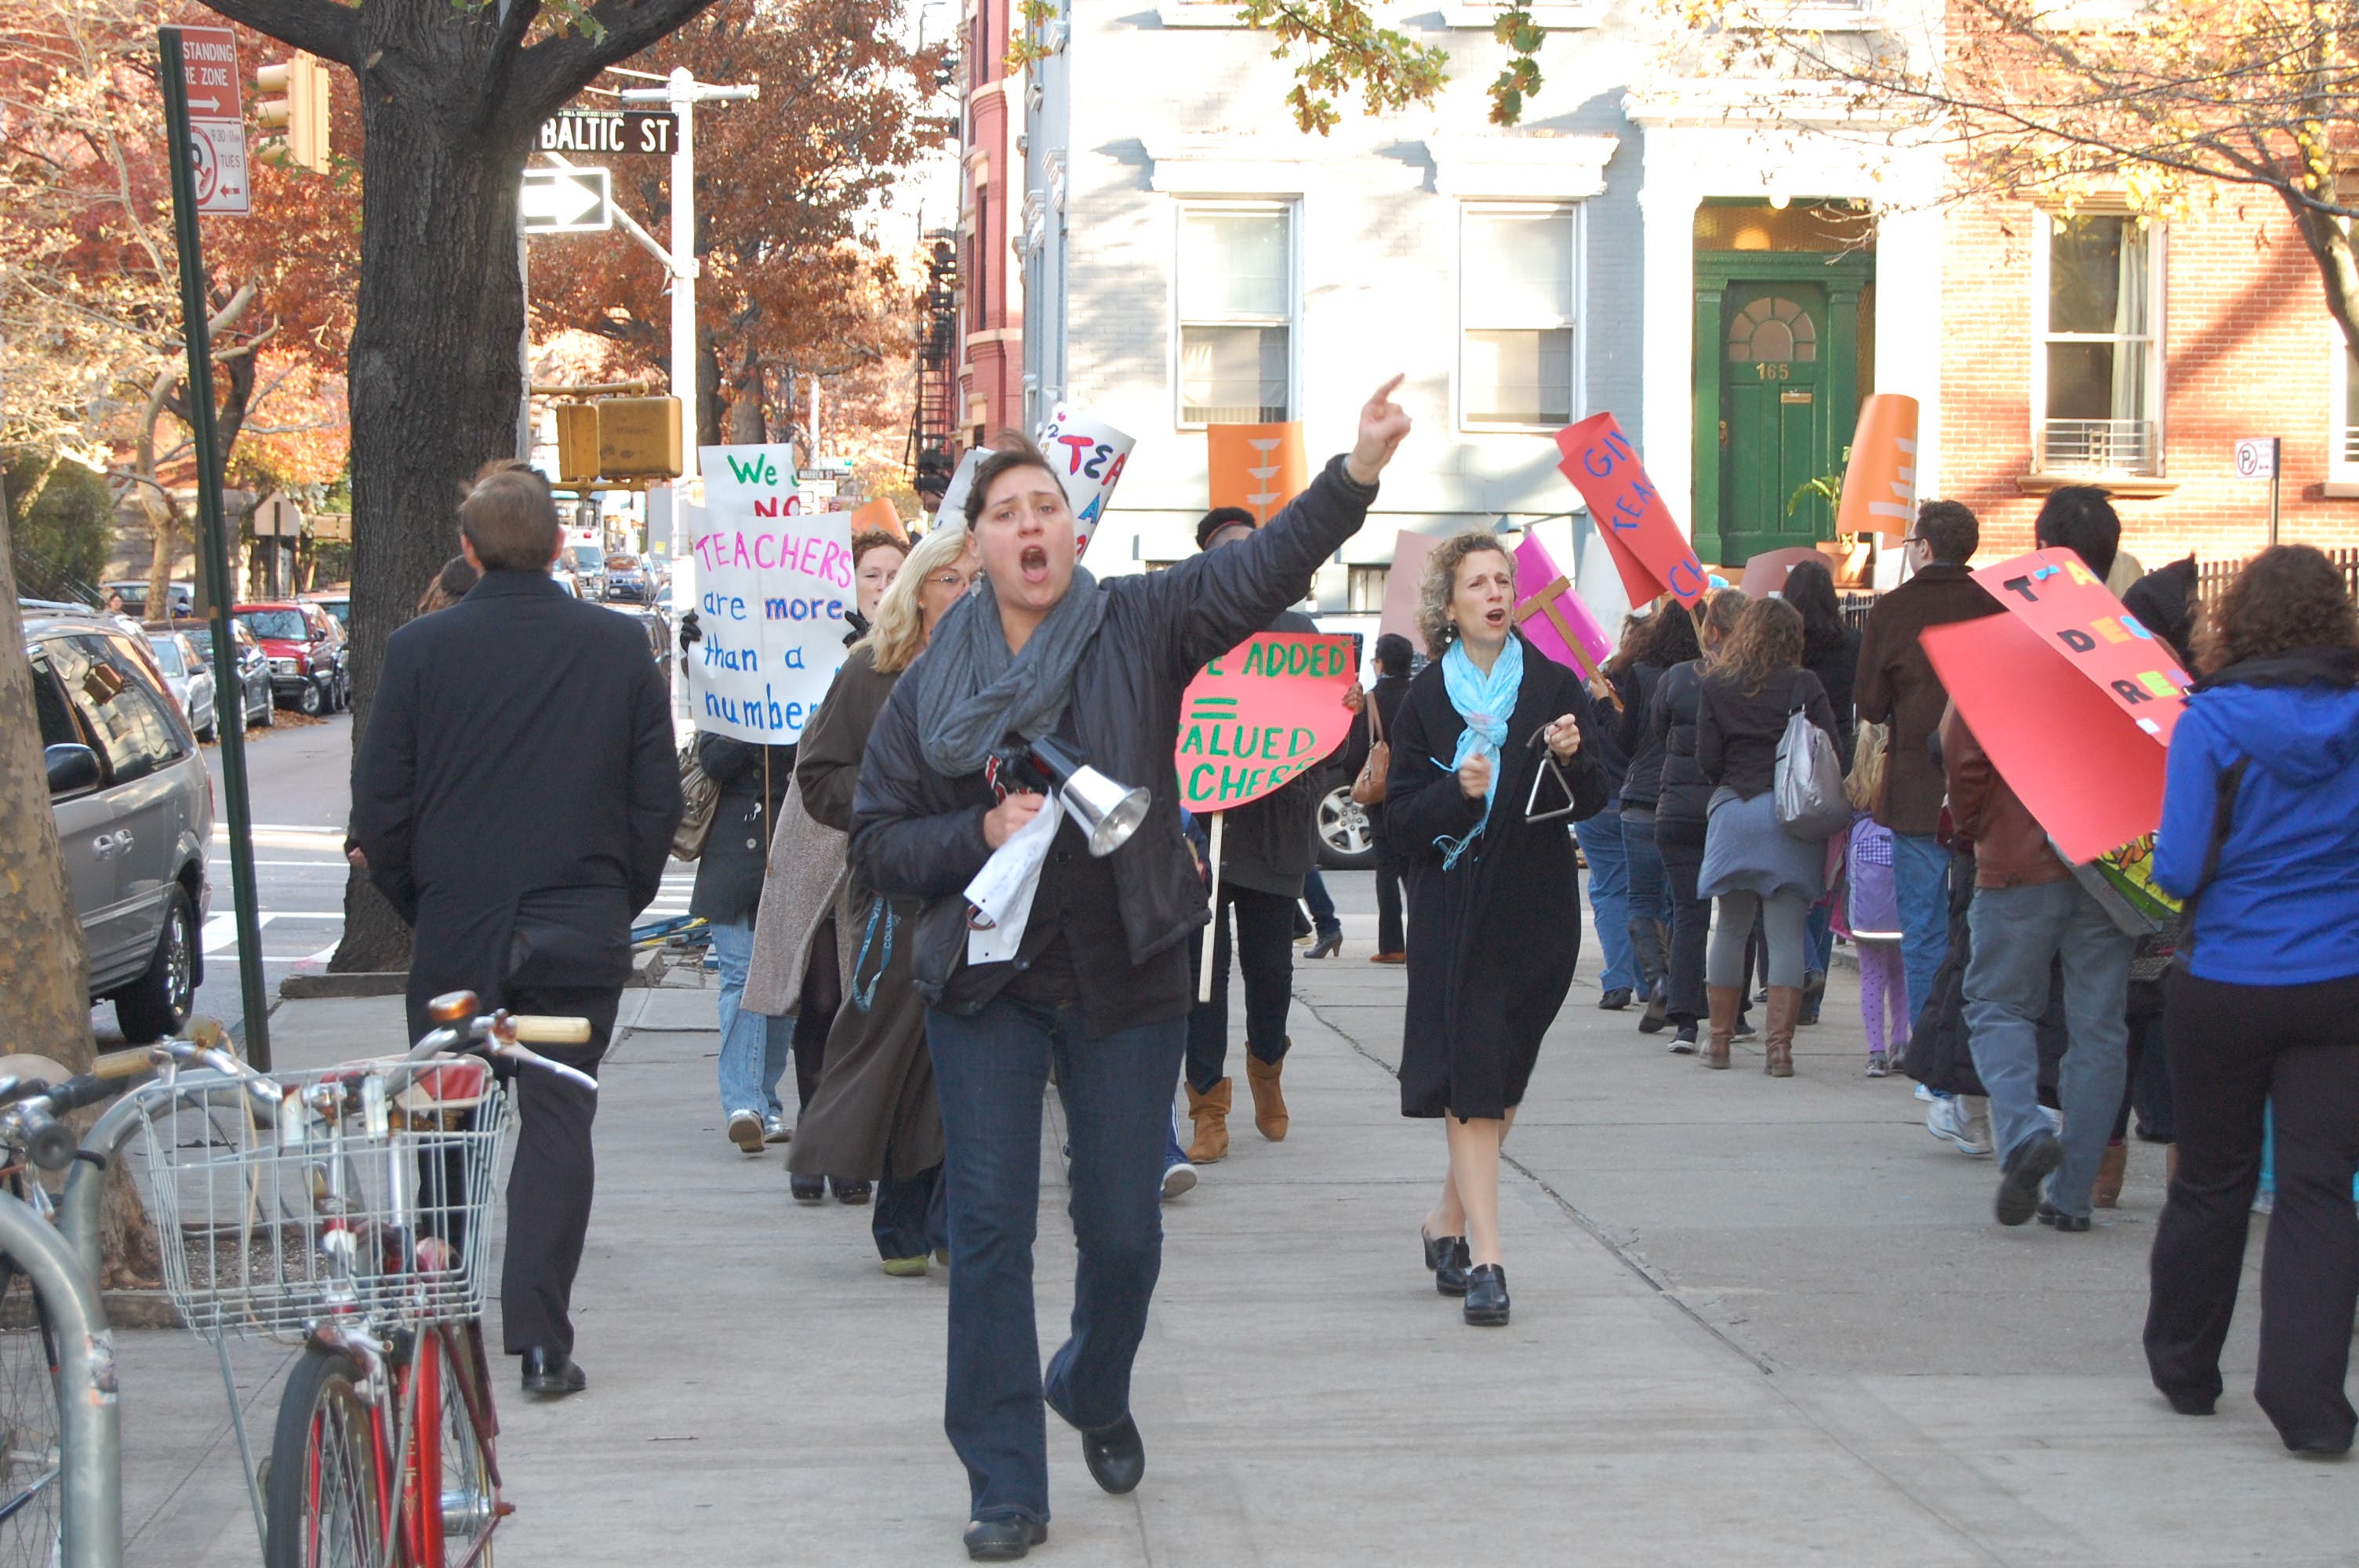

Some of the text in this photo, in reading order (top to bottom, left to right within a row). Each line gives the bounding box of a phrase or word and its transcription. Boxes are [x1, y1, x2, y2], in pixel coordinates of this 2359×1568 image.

[183, 41, 234, 63] STANDING
[201, 67, 229, 86] ZONE
[541, 117, 670, 152] BALTIC ST
[220, 154, 241, 168] TUES
[1757, 362, 1790, 381] 165
[727, 453, 778, 486] We
[695, 531, 852, 589] TEACHERS
[703, 590, 843, 622] are more
[703, 633, 805, 672] than a
[1178, 723, 1317, 760] ALUED
[1176, 757, 1316, 802] CHER
